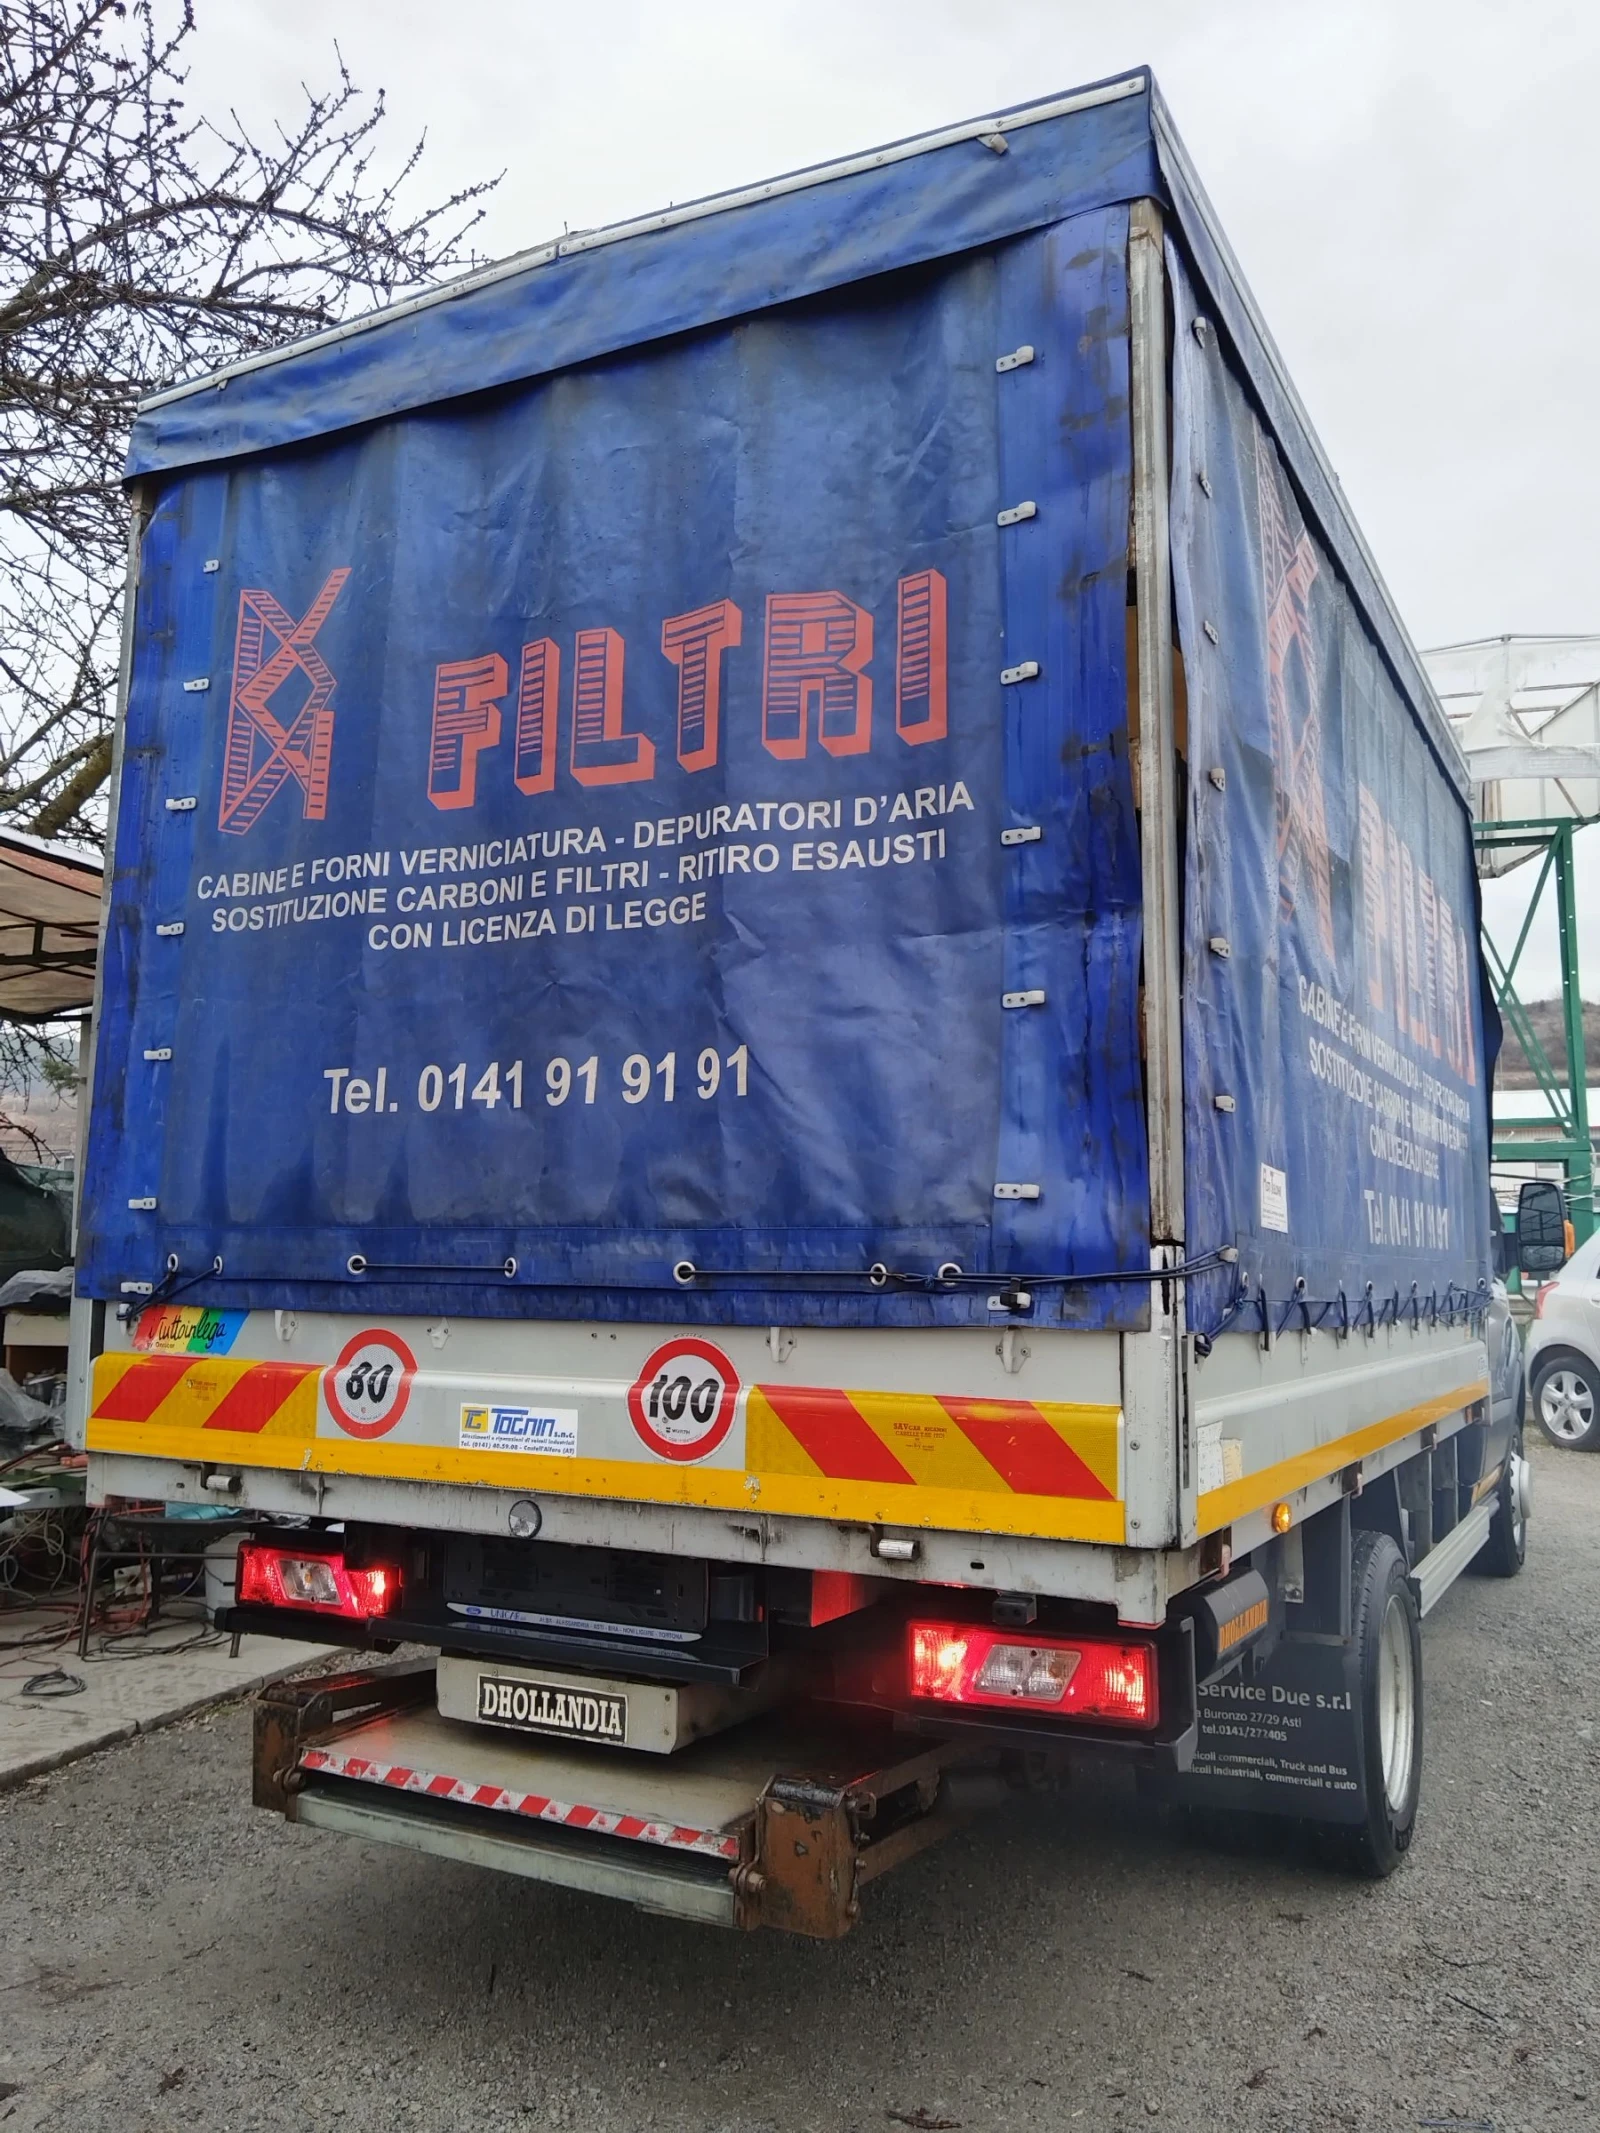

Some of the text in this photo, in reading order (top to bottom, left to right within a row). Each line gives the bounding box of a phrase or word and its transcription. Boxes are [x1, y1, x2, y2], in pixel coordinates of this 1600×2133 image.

[427, 568, 947, 811] FILTRI
[197, 867, 287, 901] CABINE
[291, 862, 306, 887] E
[311, 851, 391, 884] FORNI
[400, 827, 606, 875] VERNICIATURA
[634, 799, 841, 849] DEPURATORI
[854, 781, 974, 826] D'ARIA
[212, 888, 387, 933] SOSTITUZIONE
[396, 874, 523, 912] CARBONI
[531, 870, 547, 897] E
[556, 861, 649, 895] FILTRI
[679, 843, 780, 884] RITIRO
[791, 828, 946, 871] ESAUSTI
[368, 892, 706, 950] CON LICENZA DI LEGGE
[323, 1044, 748, 1114] Tel. 0141 91 91 91
[1364, 1190, 1387, 1245] Tel.
[346, 1361, 394, 1404] 80
[649, 1374, 720, 1423] 100
[483, 1682, 623, 1736] DHOLLANDIA
[1198, 1682, 1352, 1710] Service Due s.r.l
[1203, 1708, 1248, 1721] Buronzo
[1249, 1712, 1280, 1725] 27/29
[1282, 1716, 1302, 1728] Asti
[1280, 1759, 1306, 1772] Truck
[1308, 1764, 1327, 1775] and
[1328, 1765, 1348, 1776] Bus
[1334, 1779, 1358, 1791] auto
